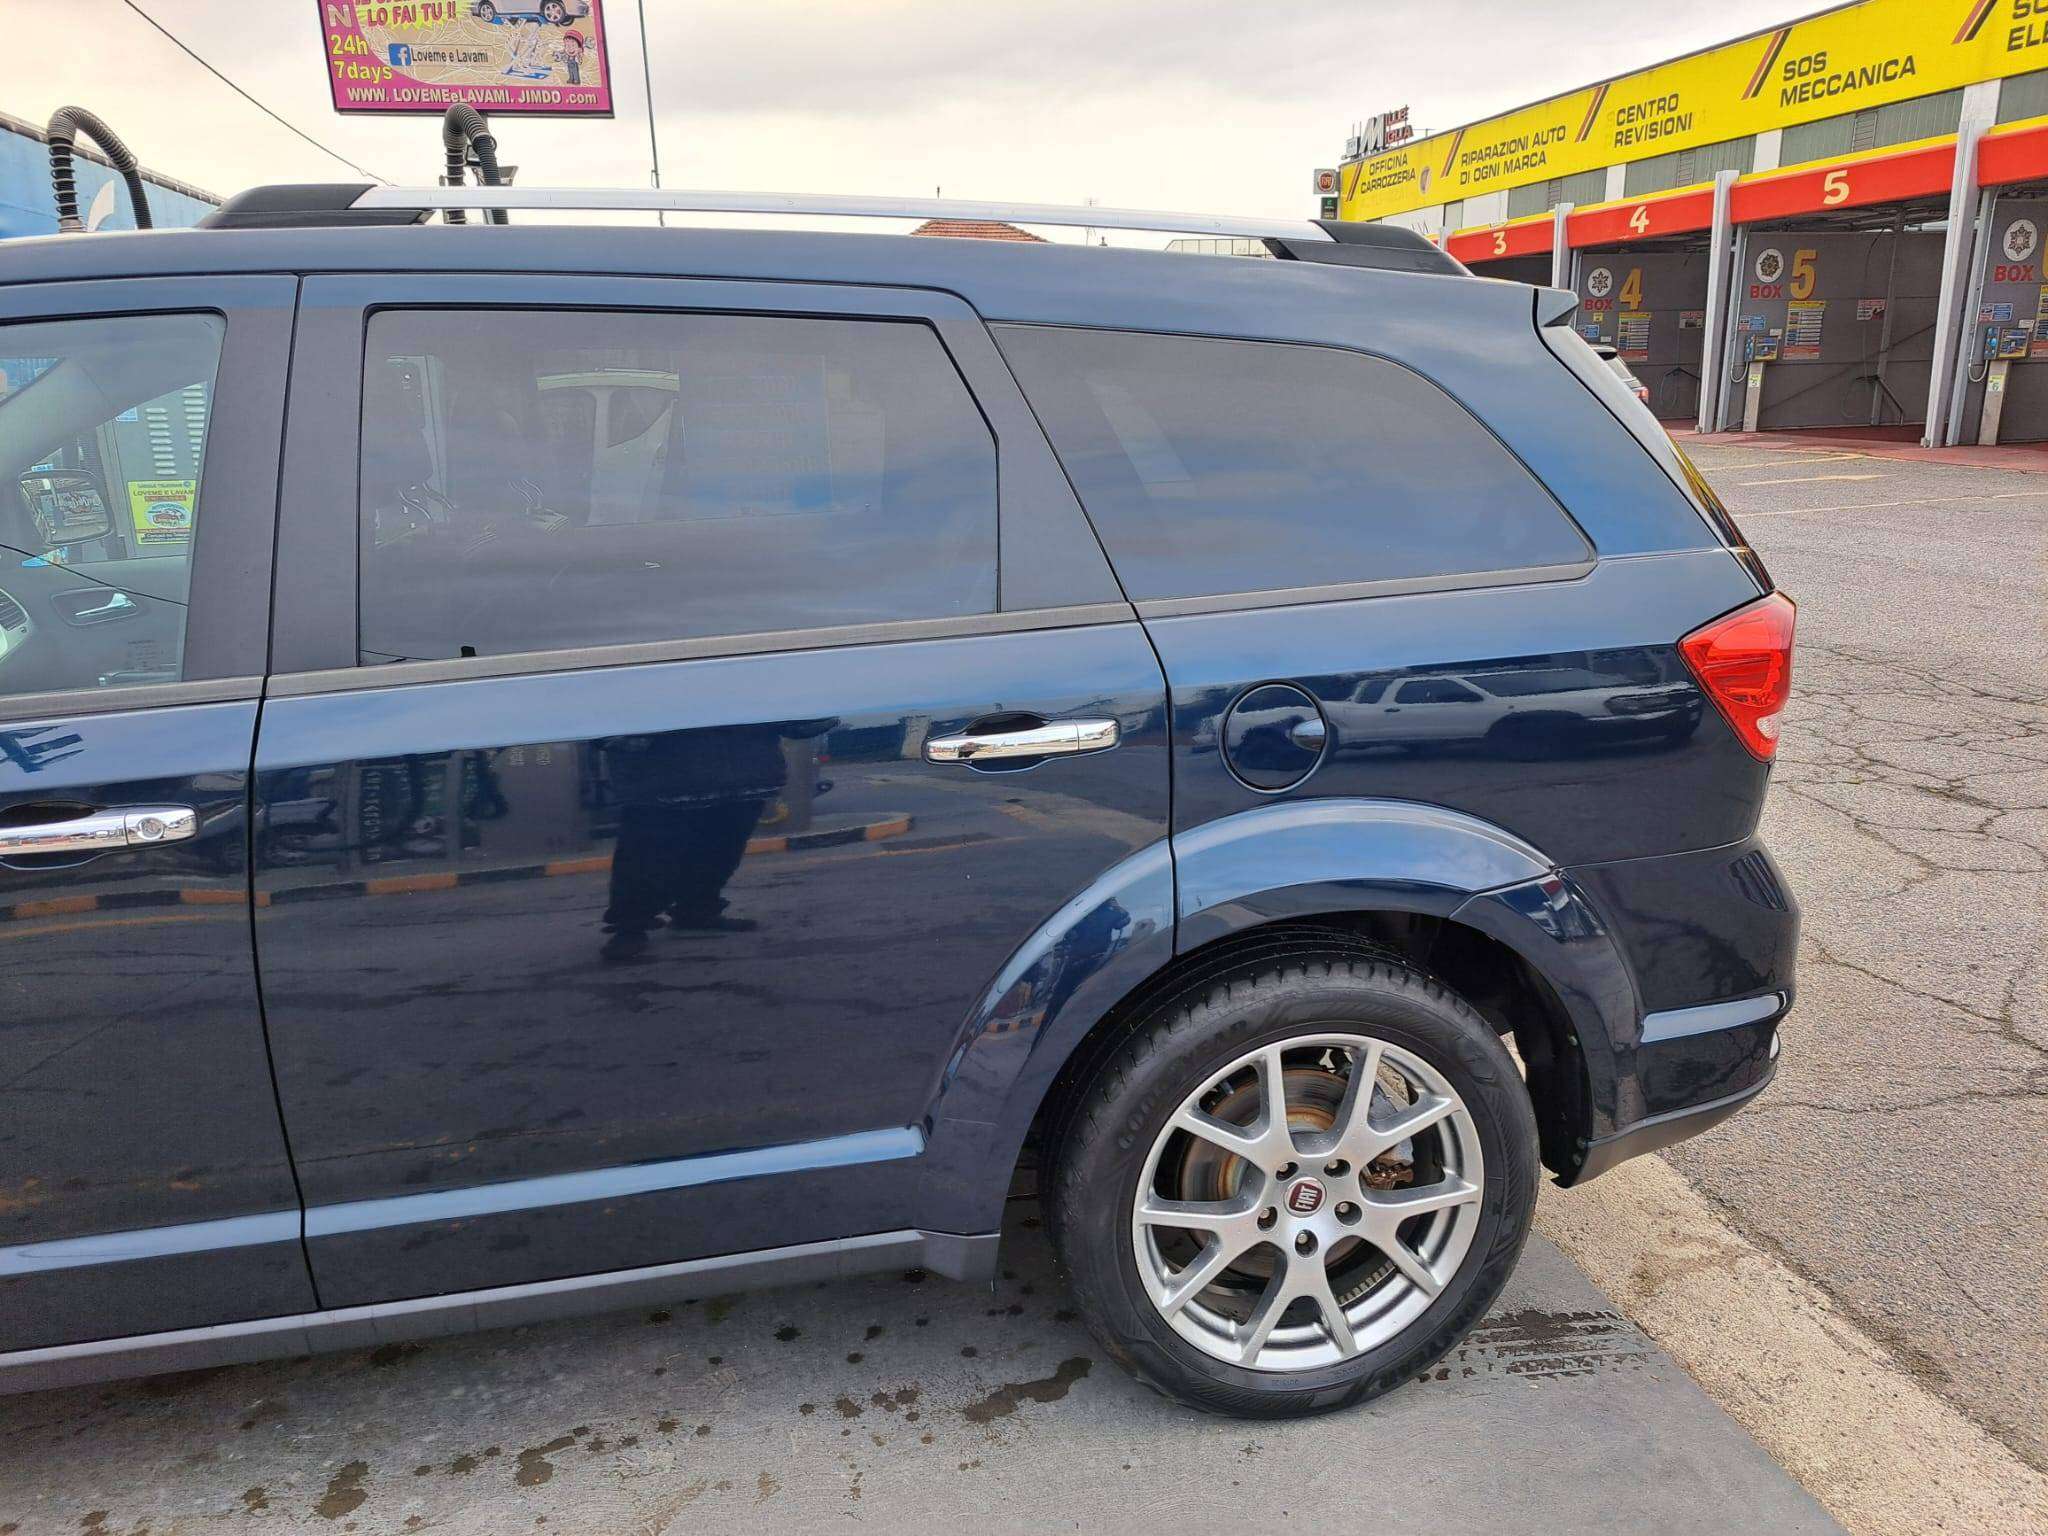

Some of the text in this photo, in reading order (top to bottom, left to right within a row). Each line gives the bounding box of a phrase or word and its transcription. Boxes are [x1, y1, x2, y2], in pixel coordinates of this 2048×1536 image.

[327, 4, 352, 27] N
[368, 8, 388, 27] LO
[393, 5, 416, 24] FAI
[421, 3, 443, 21] TU
[331, 34, 368, 55] 24h
[411, 49, 446, 62] Loveme
[449, 53, 455, 62] e
[457, 49, 488, 63] Lavami
[333, 60, 392, 84] 7days
[1783, 51, 1827, 82] SOS
[1780, 55, 1917, 108] MECCANICA
[518, 89, 562, 104] JIMDO
[1616, 93, 1679, 126] CENTRO
[1614, 112, 1692, 148] REVISIONI
[1461, 125, 1566, 167] RIPARAZIONI AUTO
[1369, 152, 1408, 176] OFFICINA
[1460, 150, 1546, 185] DI OGNI MARCA
[1360, 168, 1416, 194] CARROZZERIA
[1823, 169, 1849, 205] 5
[1629, 206, 1650, 234] 4
[1493, 231, 1507, 255] 3
[1750, 249, 1818, 301] BOX 5
[1993, 264, 2035, 283] BOX
[1584, 266, 1643, 311] BOX 4
[1295, 1184, 1319, 1210] FIAT
